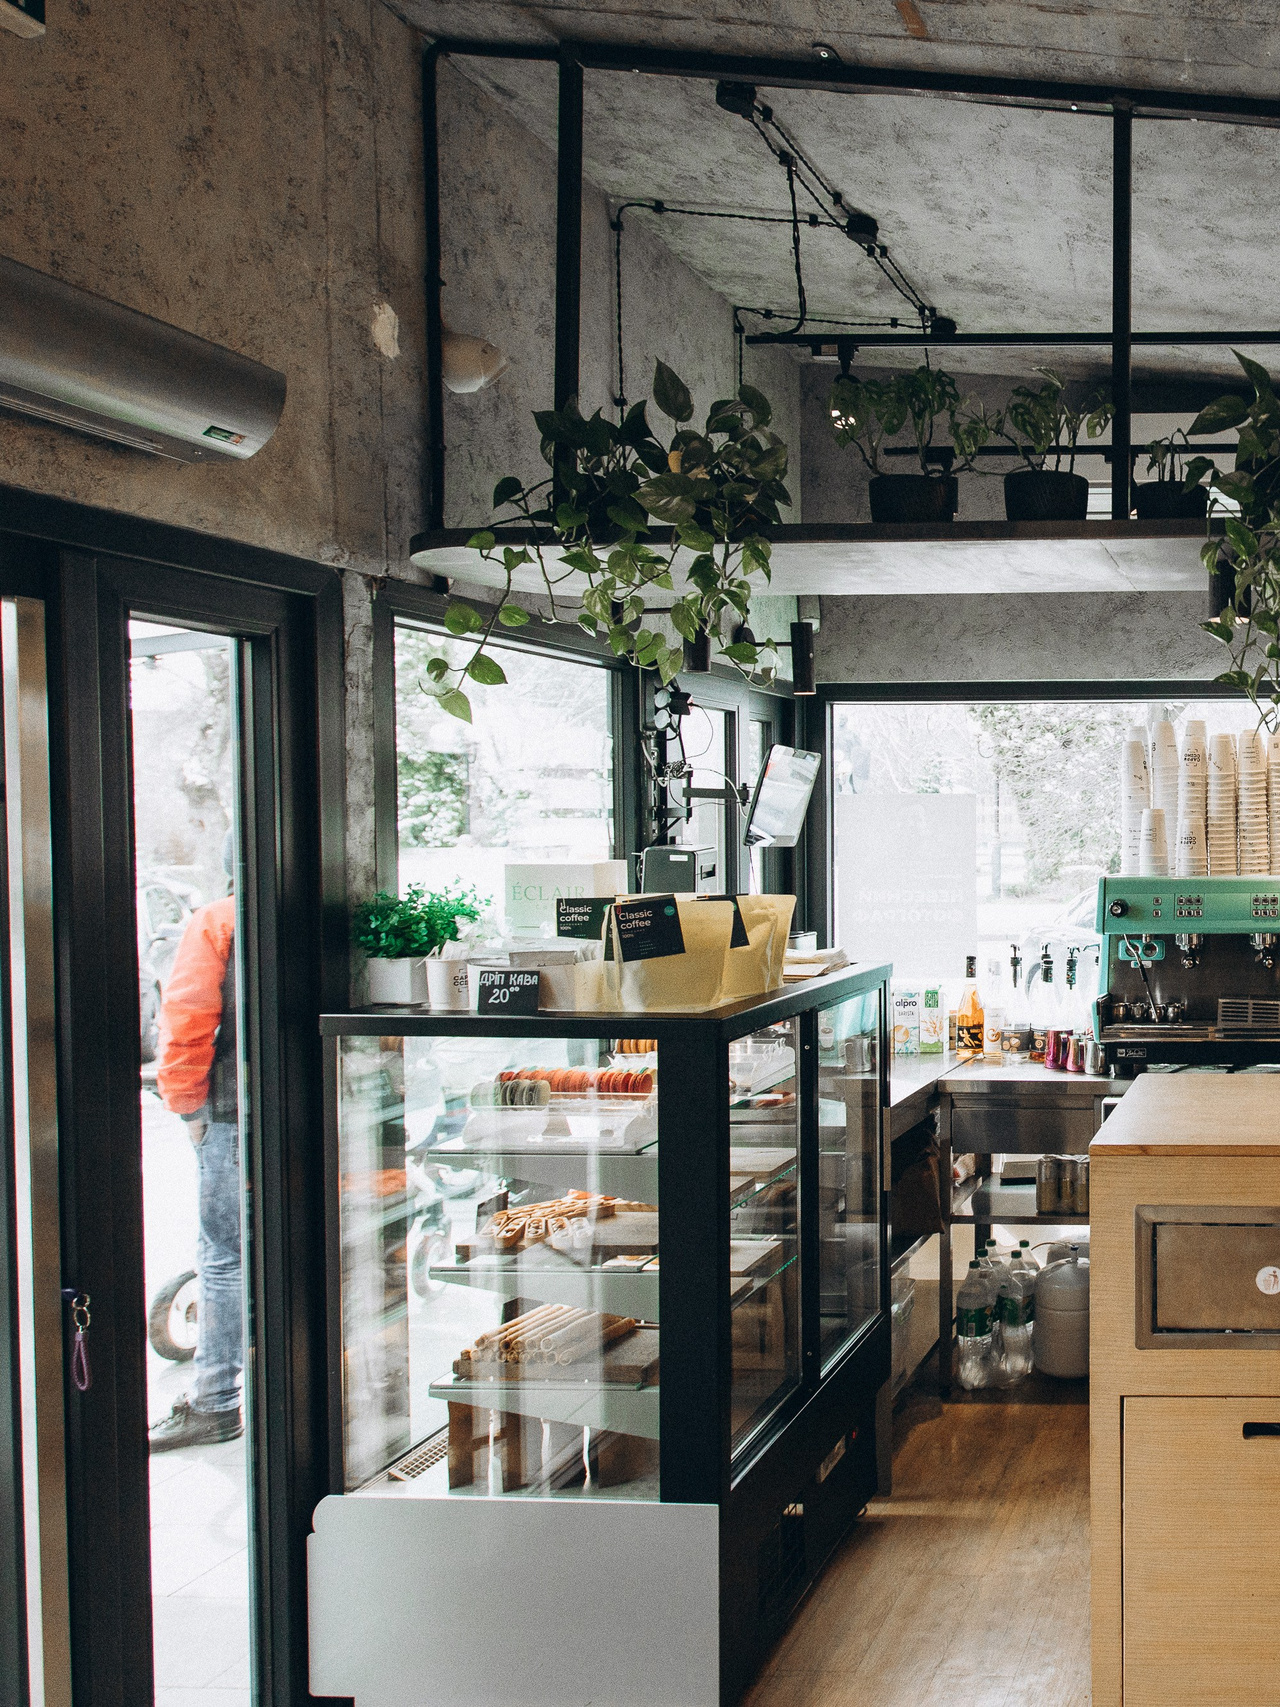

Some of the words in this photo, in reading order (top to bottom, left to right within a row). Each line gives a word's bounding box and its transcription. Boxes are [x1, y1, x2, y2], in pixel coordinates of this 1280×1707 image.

[511, 881, 585, 901] ÉCLAIR
[560, 904, 592, 914] Classic
[619, 909, 653, 920] Classic
[560, 914, 589, 922] coffee
[620, 919, 651, 930] coffee
[509, 973, 538, 986] КАВА
[895, 998, 917, 1008] alpro
